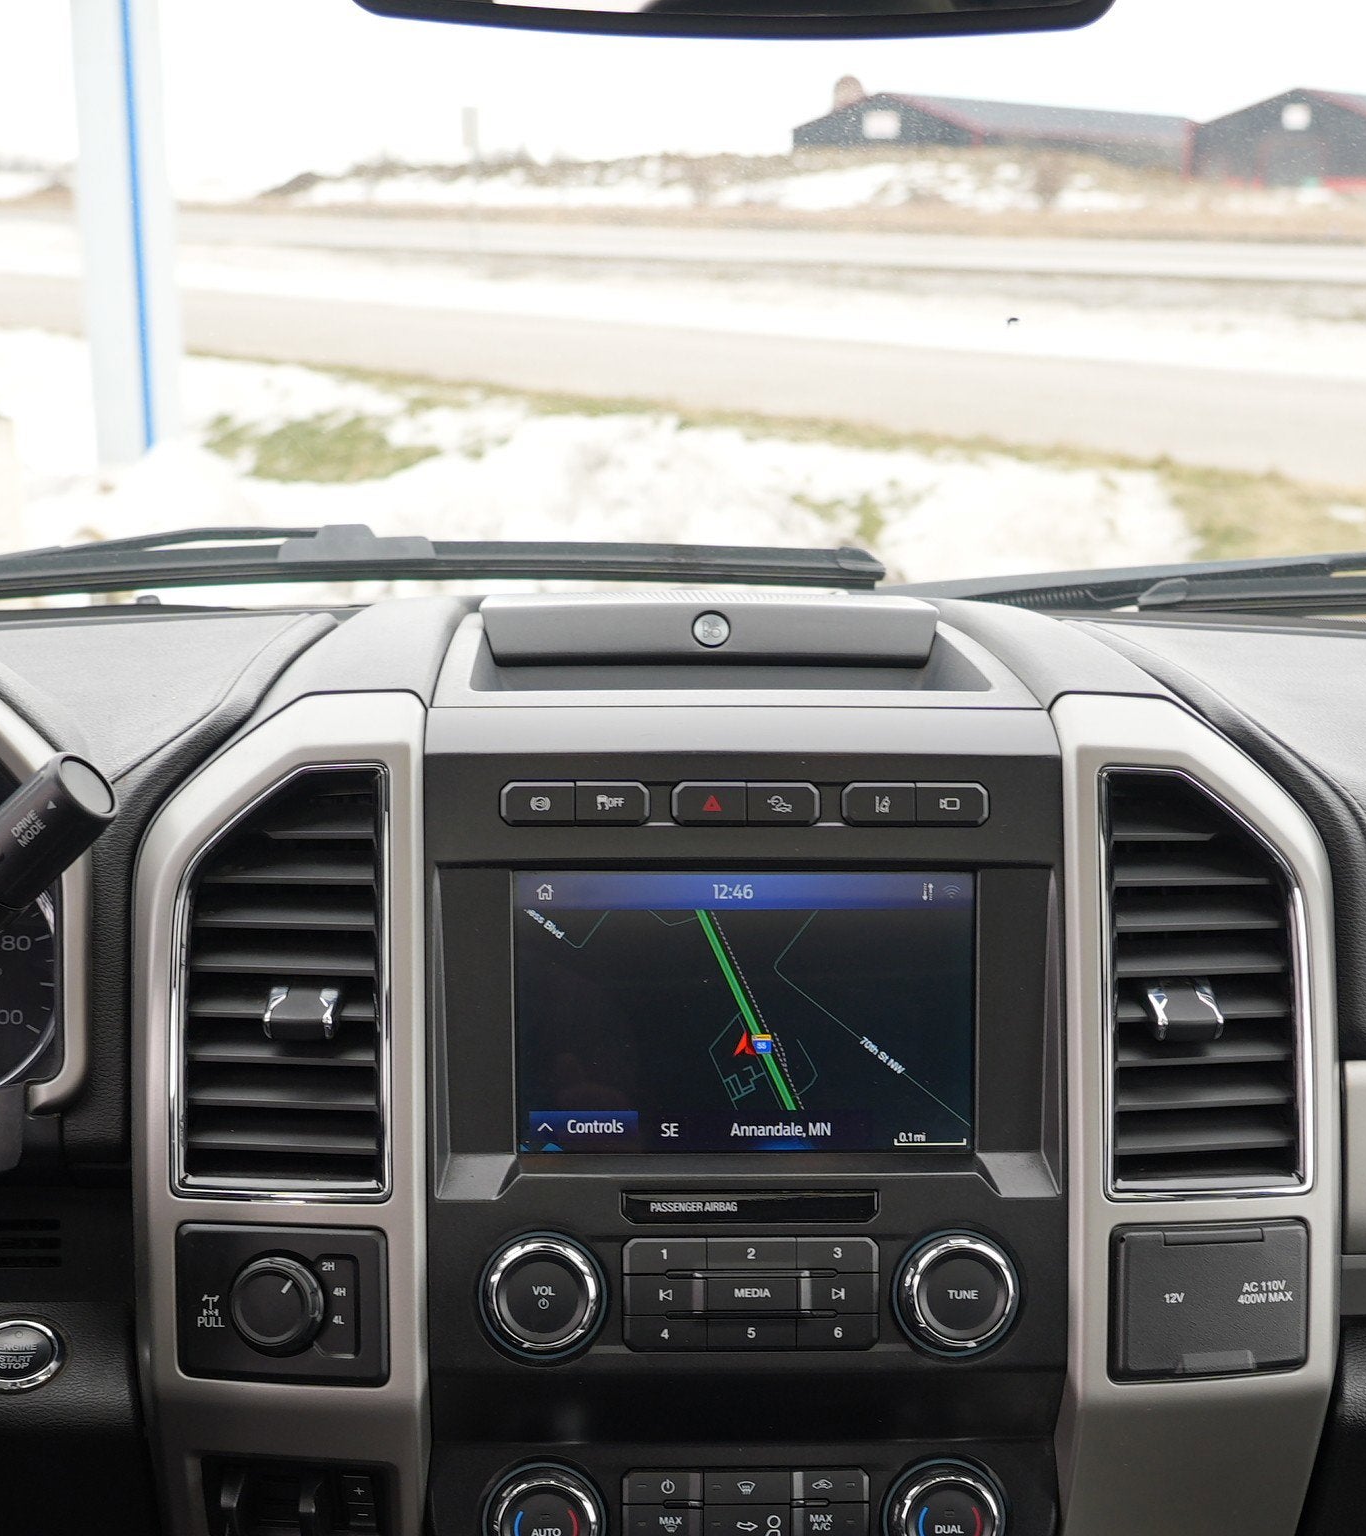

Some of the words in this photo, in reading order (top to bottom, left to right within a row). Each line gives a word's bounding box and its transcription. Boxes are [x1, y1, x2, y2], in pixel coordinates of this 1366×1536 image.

[608, 796, 625, 809] OFF
[10, 808, 39, 839] DRIVE
[16, 819, 47, 848] MODE
[713, 883, 755, 900] 12:46
[543, 919, 565, 939] Blvd
[0, 935, 32, 952] 80
[859, 1036, 879, 1055] 70th
[876, 1051, 890, 1064] St
[566, 1118, 624, 1135] Controls
[661, 1123, 679, 1138] SE
[730, 1122, 807, 1138] Annandale,
[808, 1123, 832, 1137] MN
[898, 1132, 913, 1143] 0.1
[913, 1132, 926, 1143] mi
[649, 1201, 702, 1213] PASSENGER
[703, 1201, 738, 1213] AIRBAG
[660, 1247, 668, 1260] 1
[746, 1247, 756, 1260] 2
[832, 1247, 843, 1259] 3
[321, 1261, 336, 1272] 2H
[332, 1286, 347, 1298] 4H
[531, 1285, 556, 1298] VOL
[1242, 1282, 1259, 1292] AC
[1261, 1280, 1286, 1291] 110V
[733, 1287, 771, 1299] MEDIA
[947, 1289, 979, 1301] TUNE
[1164, 1292, 1185, 1303] 12V
[1237, 1293, 1267, 1304] 400W
[1267, 1291, 1293, 1302] MAX
[196, 1316, 225, 1329] PULL
[332, 1314, 345, 1326] 4L
[660, 1328, 669, 1340] 4
[747, 1327, 756, 1339] 5
[833, 1326, 843, 1338] 6
[0, 1362, 30, 1370] STOP
[658, 1516, 683, 1527] MAX
[809, 1513, 833, 1524] MAX
[811, 1522, 832, 1532] A/C
[934, 1523, 964, 1535] DUAL
